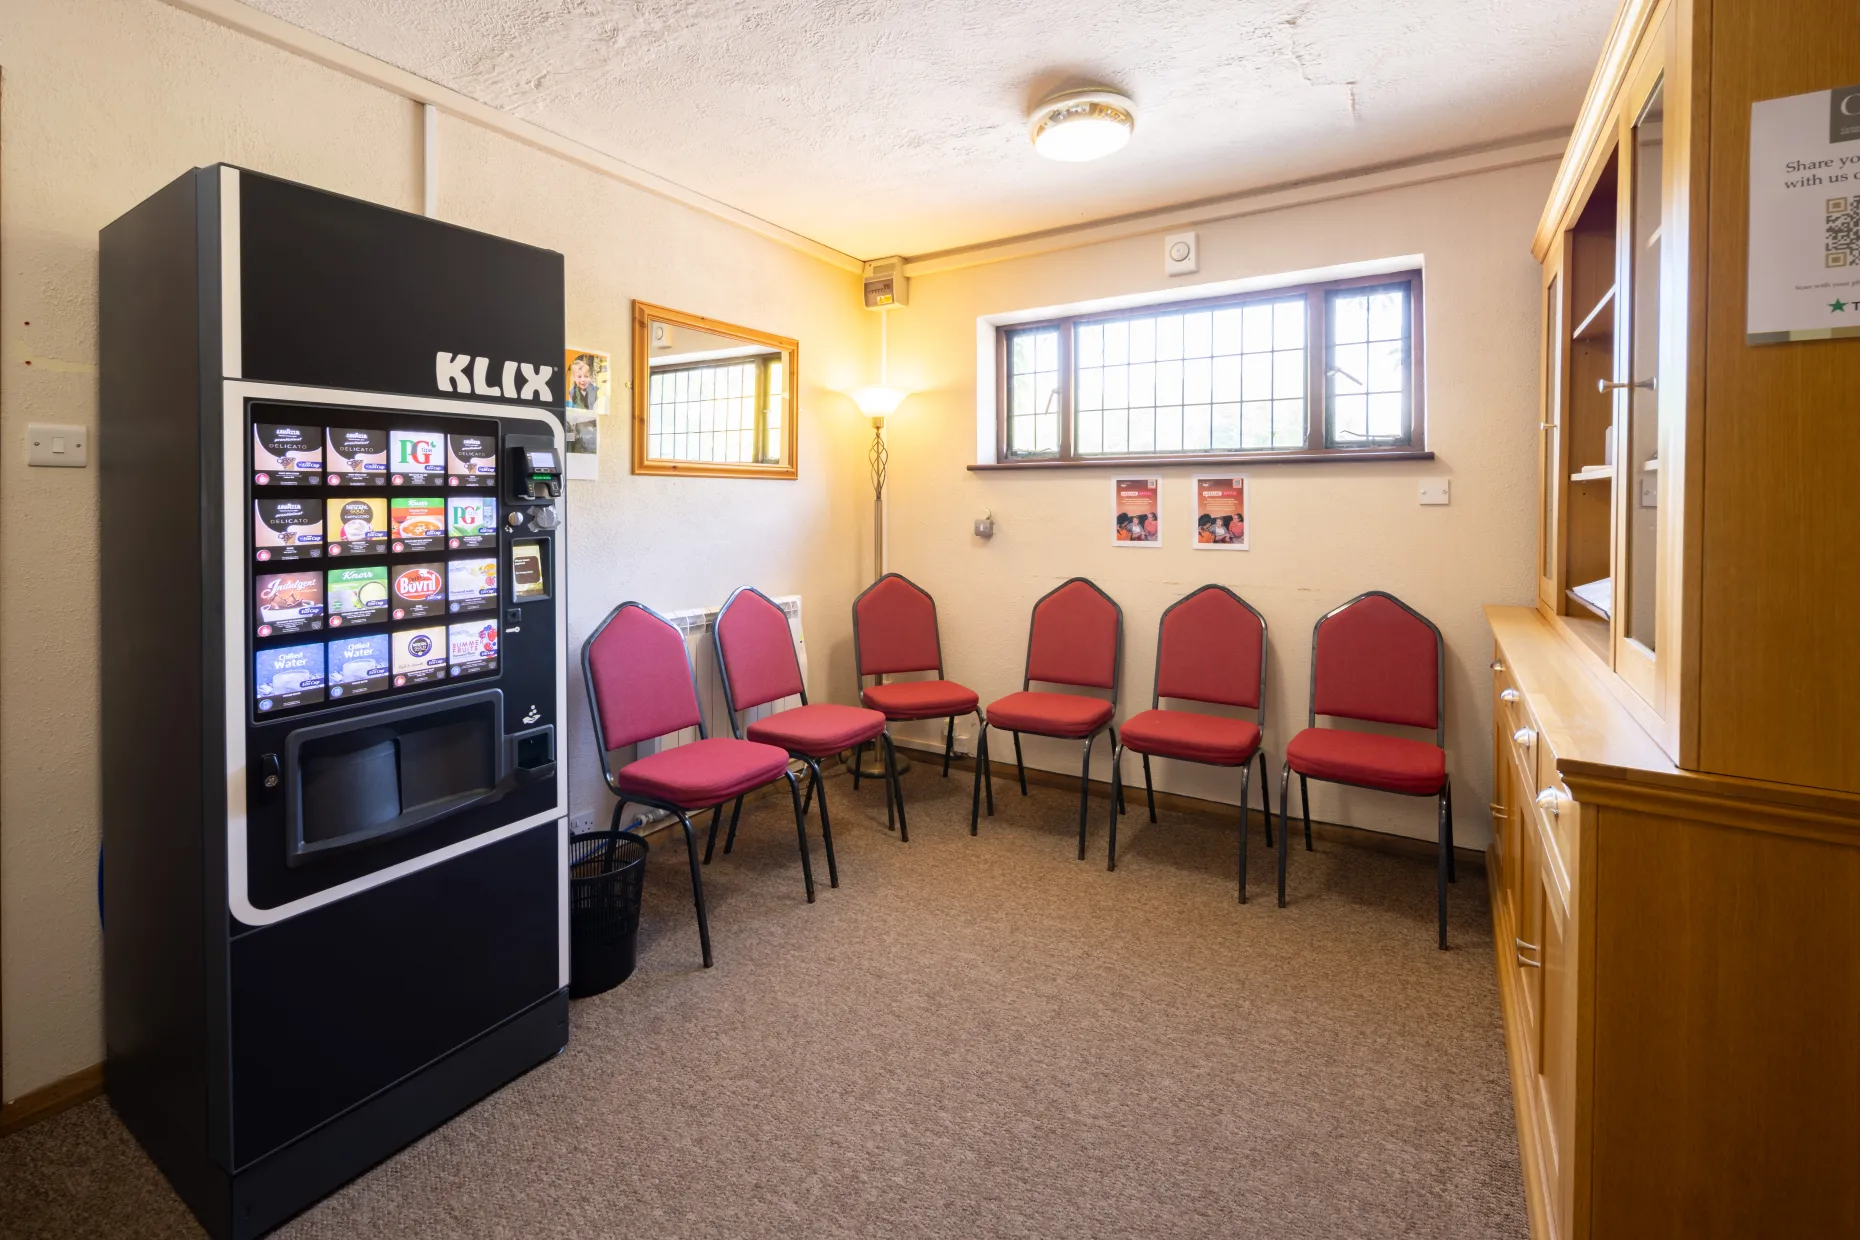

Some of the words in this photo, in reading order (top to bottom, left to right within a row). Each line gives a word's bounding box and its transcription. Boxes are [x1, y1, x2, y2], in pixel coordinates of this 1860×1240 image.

[1786, 160, 1834, 173] Share
[1785, 174, 1822, 189] with
[1829, 173, 1849, 183] us
[436, 351, 554, 403] KLIX
[399, 440, 432, 464] PG
[453, 506, 475, 524] PG
[342, 570, 374, 580] Knorr
[260, 578, 317, 599] Indulgent
[400, 574, 436, 594] Bovril
[348, 642, 370, 650] Chilled
[452, 640, 485, 649] SUMMER
[452, 645, 479, 654] FRUITS
[278, 652, 303, 660] Chilled
[343, 649, 374, 658] Water
[274, 659, 307, 669] Water
